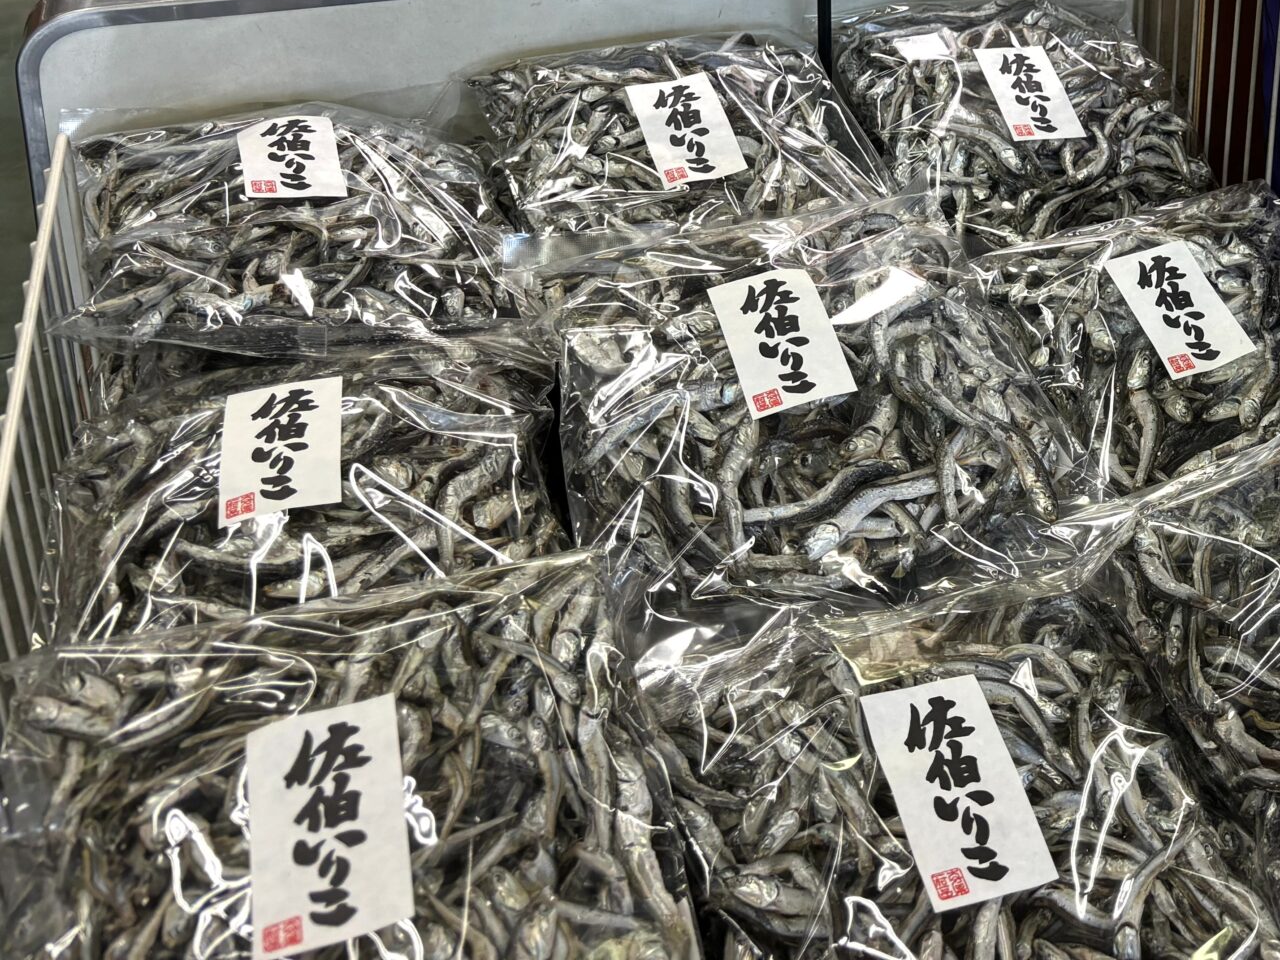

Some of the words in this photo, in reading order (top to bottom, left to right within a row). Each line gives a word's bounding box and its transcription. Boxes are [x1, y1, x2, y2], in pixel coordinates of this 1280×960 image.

[653, 83, 716, 175] 佐伯いりこ
[998, 51, 1058, 134] 佐伯いりこ
[261, 118, 316, 191] 佐伯いりこ
[741, 277, 818, 396] 佐伯いりこ
[1137, 253, 1222, 364] 佐伯いりこ
[250, 388, 320, 500] 佐伯いりこ
[283, 720, 373, 929] 佐伯いりこ
[903, 695, 1011, 882] 佐伯いりこ
